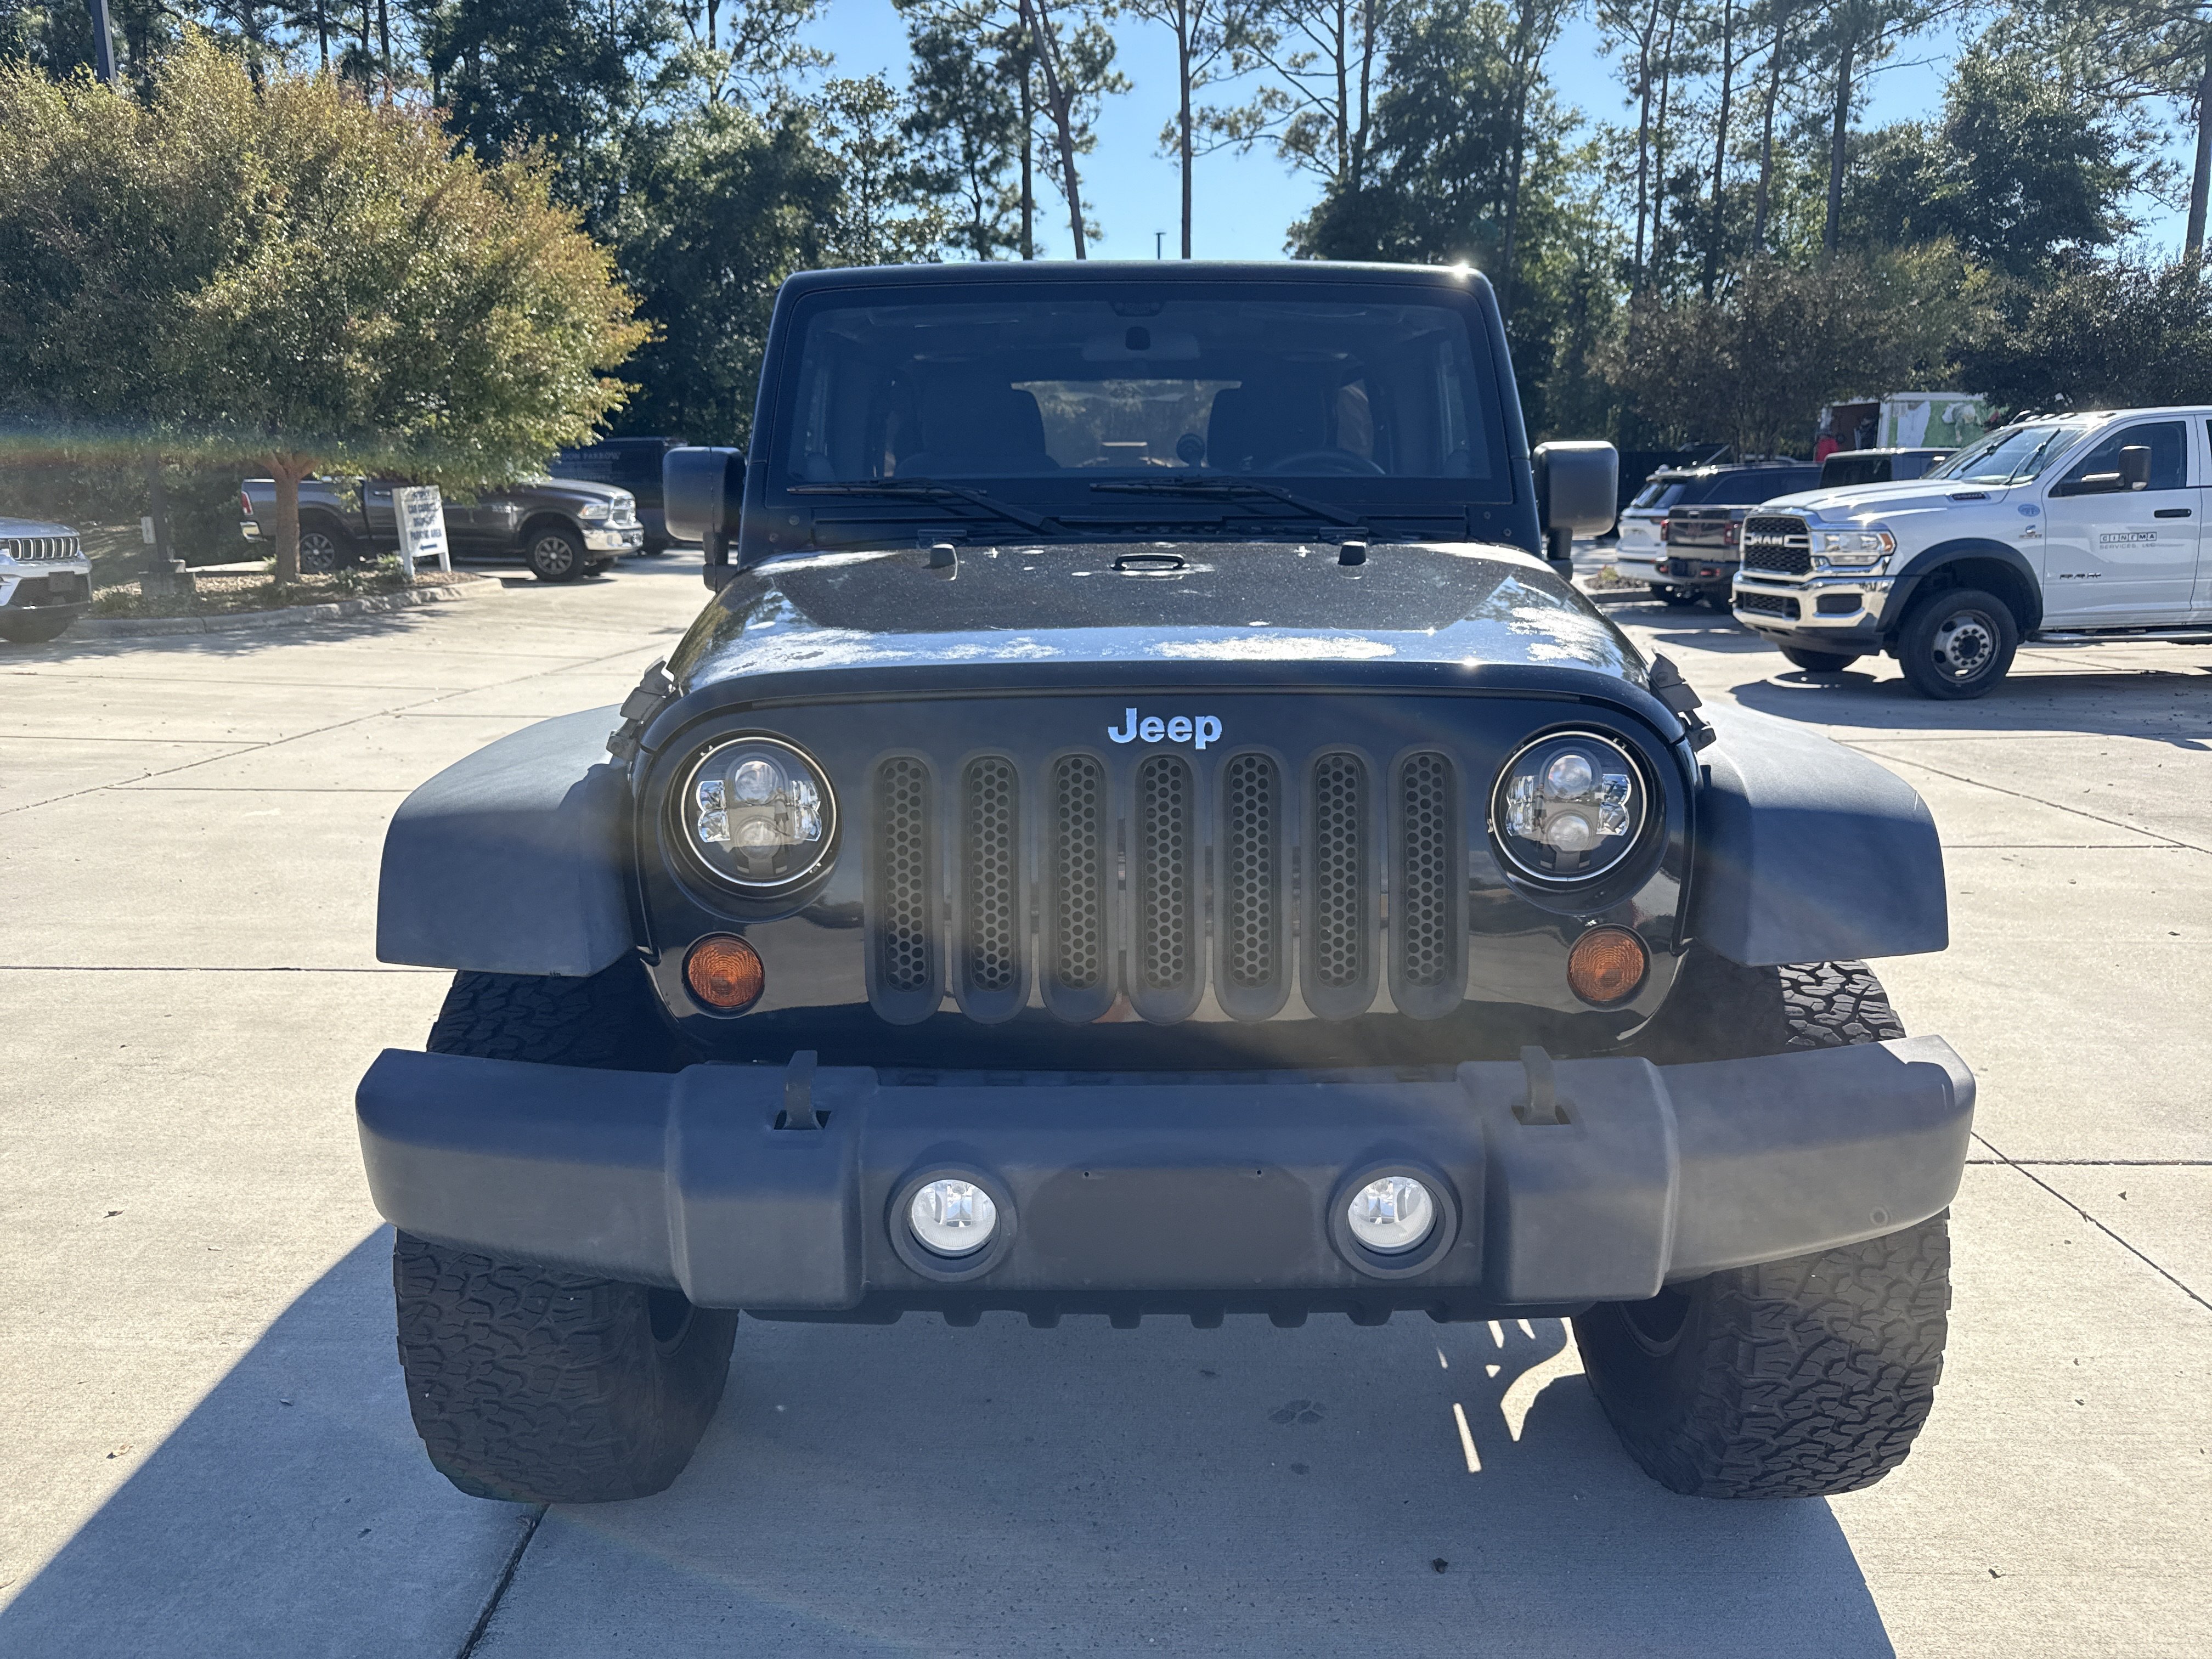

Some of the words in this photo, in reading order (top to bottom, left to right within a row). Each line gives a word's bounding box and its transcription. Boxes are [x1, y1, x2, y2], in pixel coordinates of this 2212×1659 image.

[1753, 535, 1783, 545] RAM
[2101, 532, 2157, 543] CINEMA
[1108, 707, 1222, 751] Jeep
